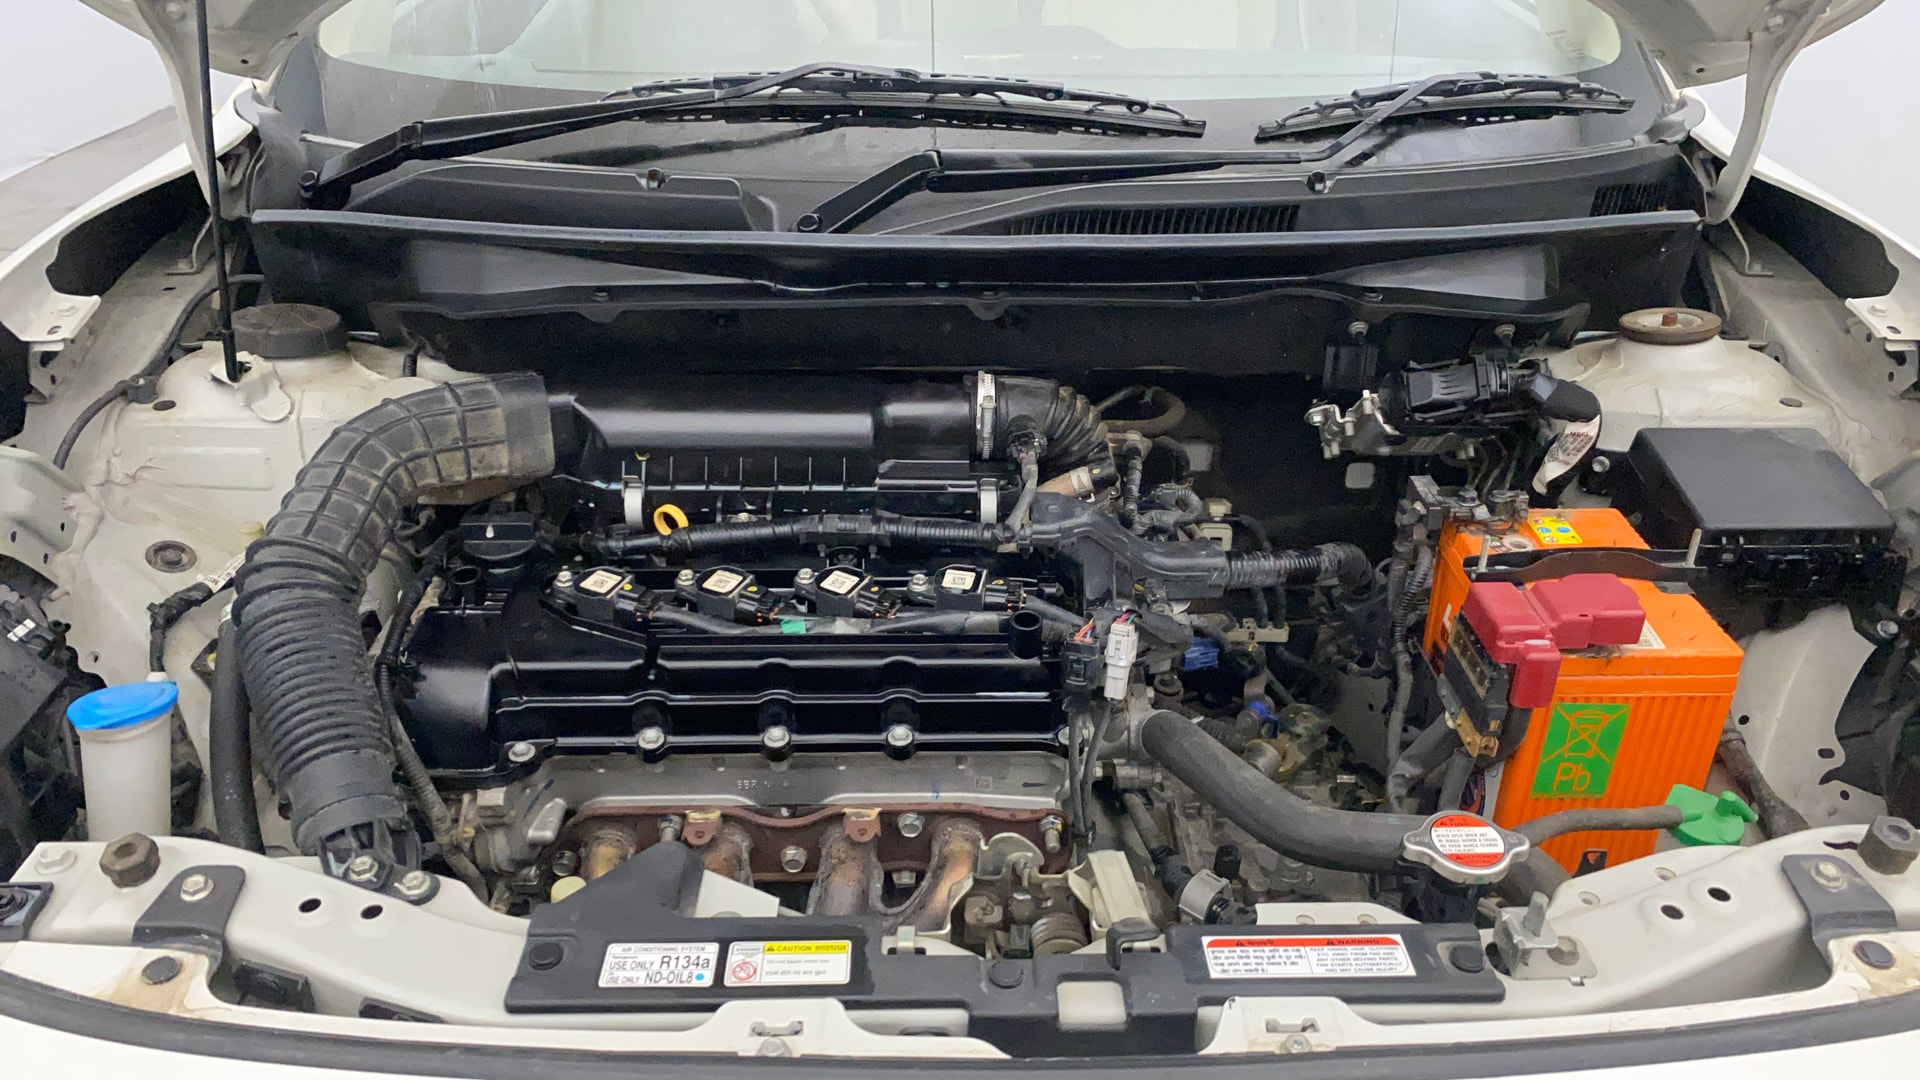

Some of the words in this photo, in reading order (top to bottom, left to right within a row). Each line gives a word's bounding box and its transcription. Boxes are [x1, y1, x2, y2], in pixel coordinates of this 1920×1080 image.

[1552, 762, 1591, 791] Pb
[609, 961, 627, 970] USE
[630, 961, 655, 970] ONLY
[659, 955, 710, 969] R134a
[605, 976, 619, 984] USE
[620, 976, 640, 984] ONLY
[644, 971, 694, 984] ND-OIL8
